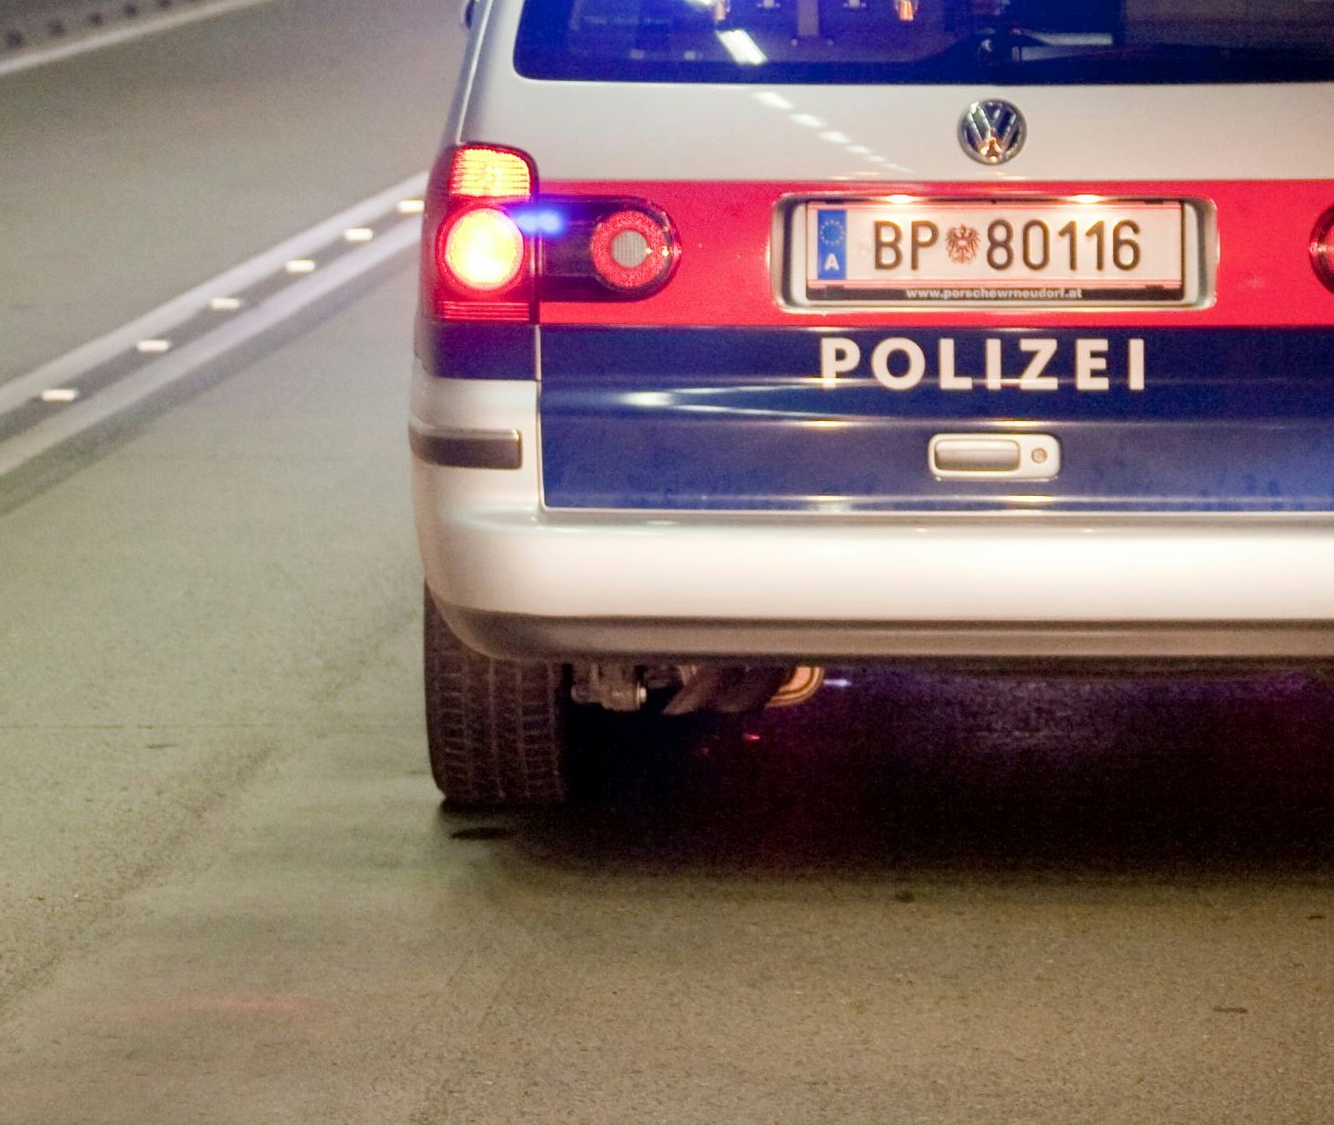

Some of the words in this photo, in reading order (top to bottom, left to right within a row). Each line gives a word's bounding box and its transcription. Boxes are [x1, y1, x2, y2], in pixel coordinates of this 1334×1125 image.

[824, 254, 840, 270] A
[874, 220, 939, 271] BP
[986, 219, 1142, 271] 80116
[905, 287, 1083, 300] www.porschewrneudorf.at
[821, 336, 1145, 390] POLIZEI
